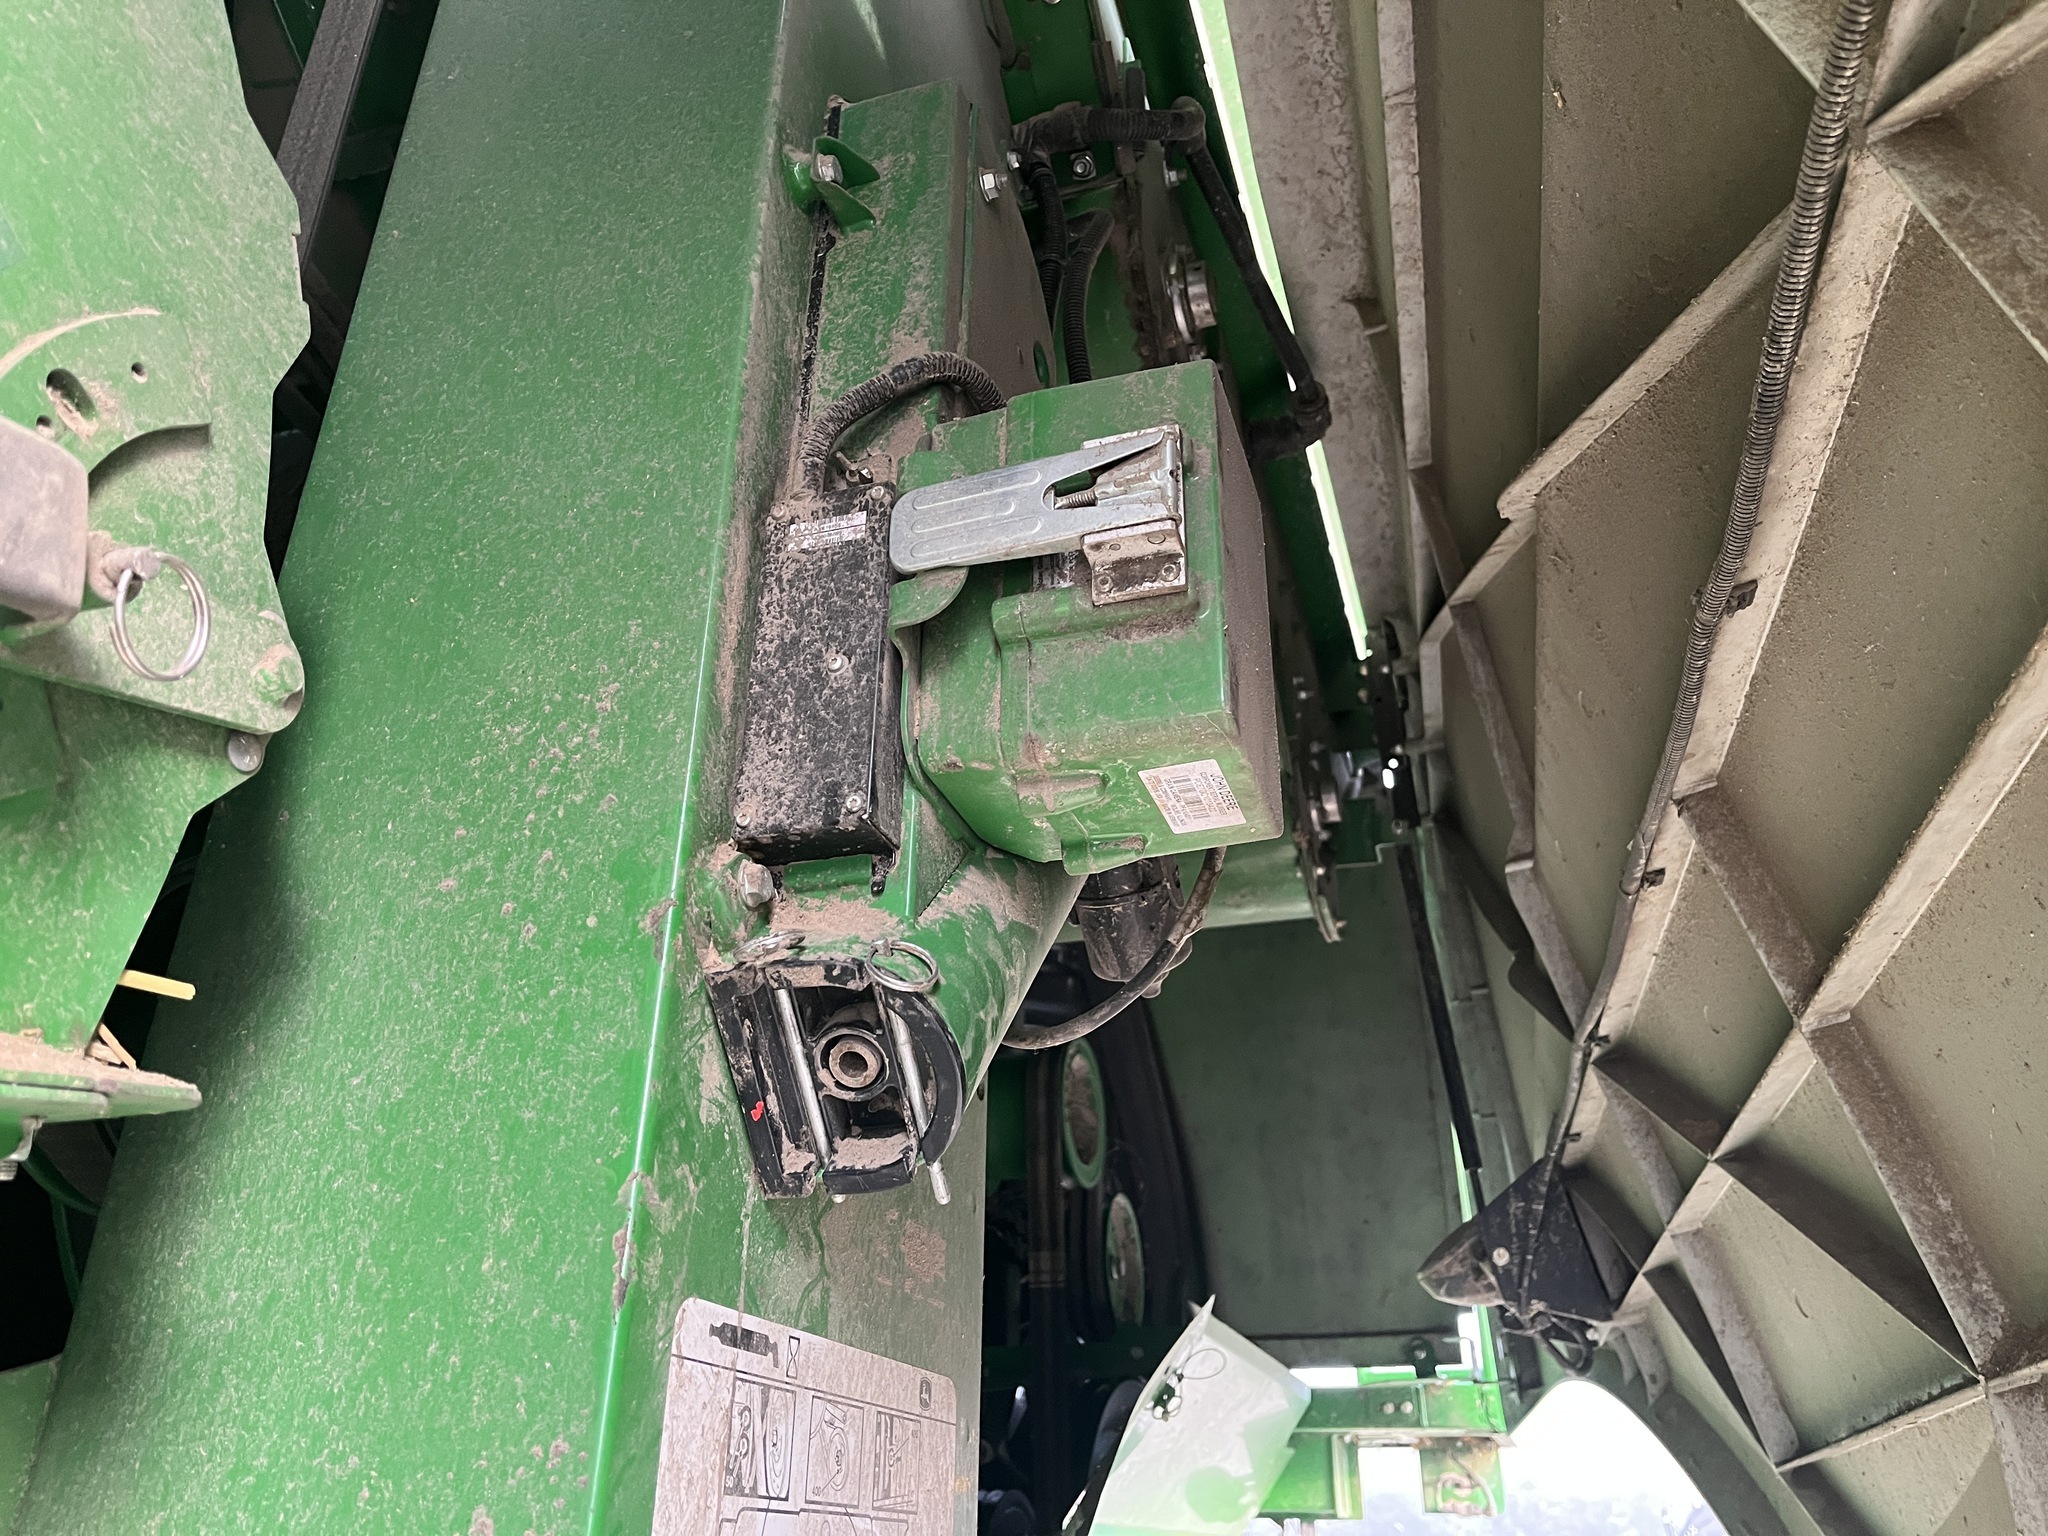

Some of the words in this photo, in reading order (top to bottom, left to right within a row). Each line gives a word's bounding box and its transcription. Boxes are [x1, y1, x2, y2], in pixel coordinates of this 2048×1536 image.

[1210, 773, 1228, 790] JOHN
[1219, 790, 1238, 810] DEERE
[725, 1475, 734, 1488] 50
